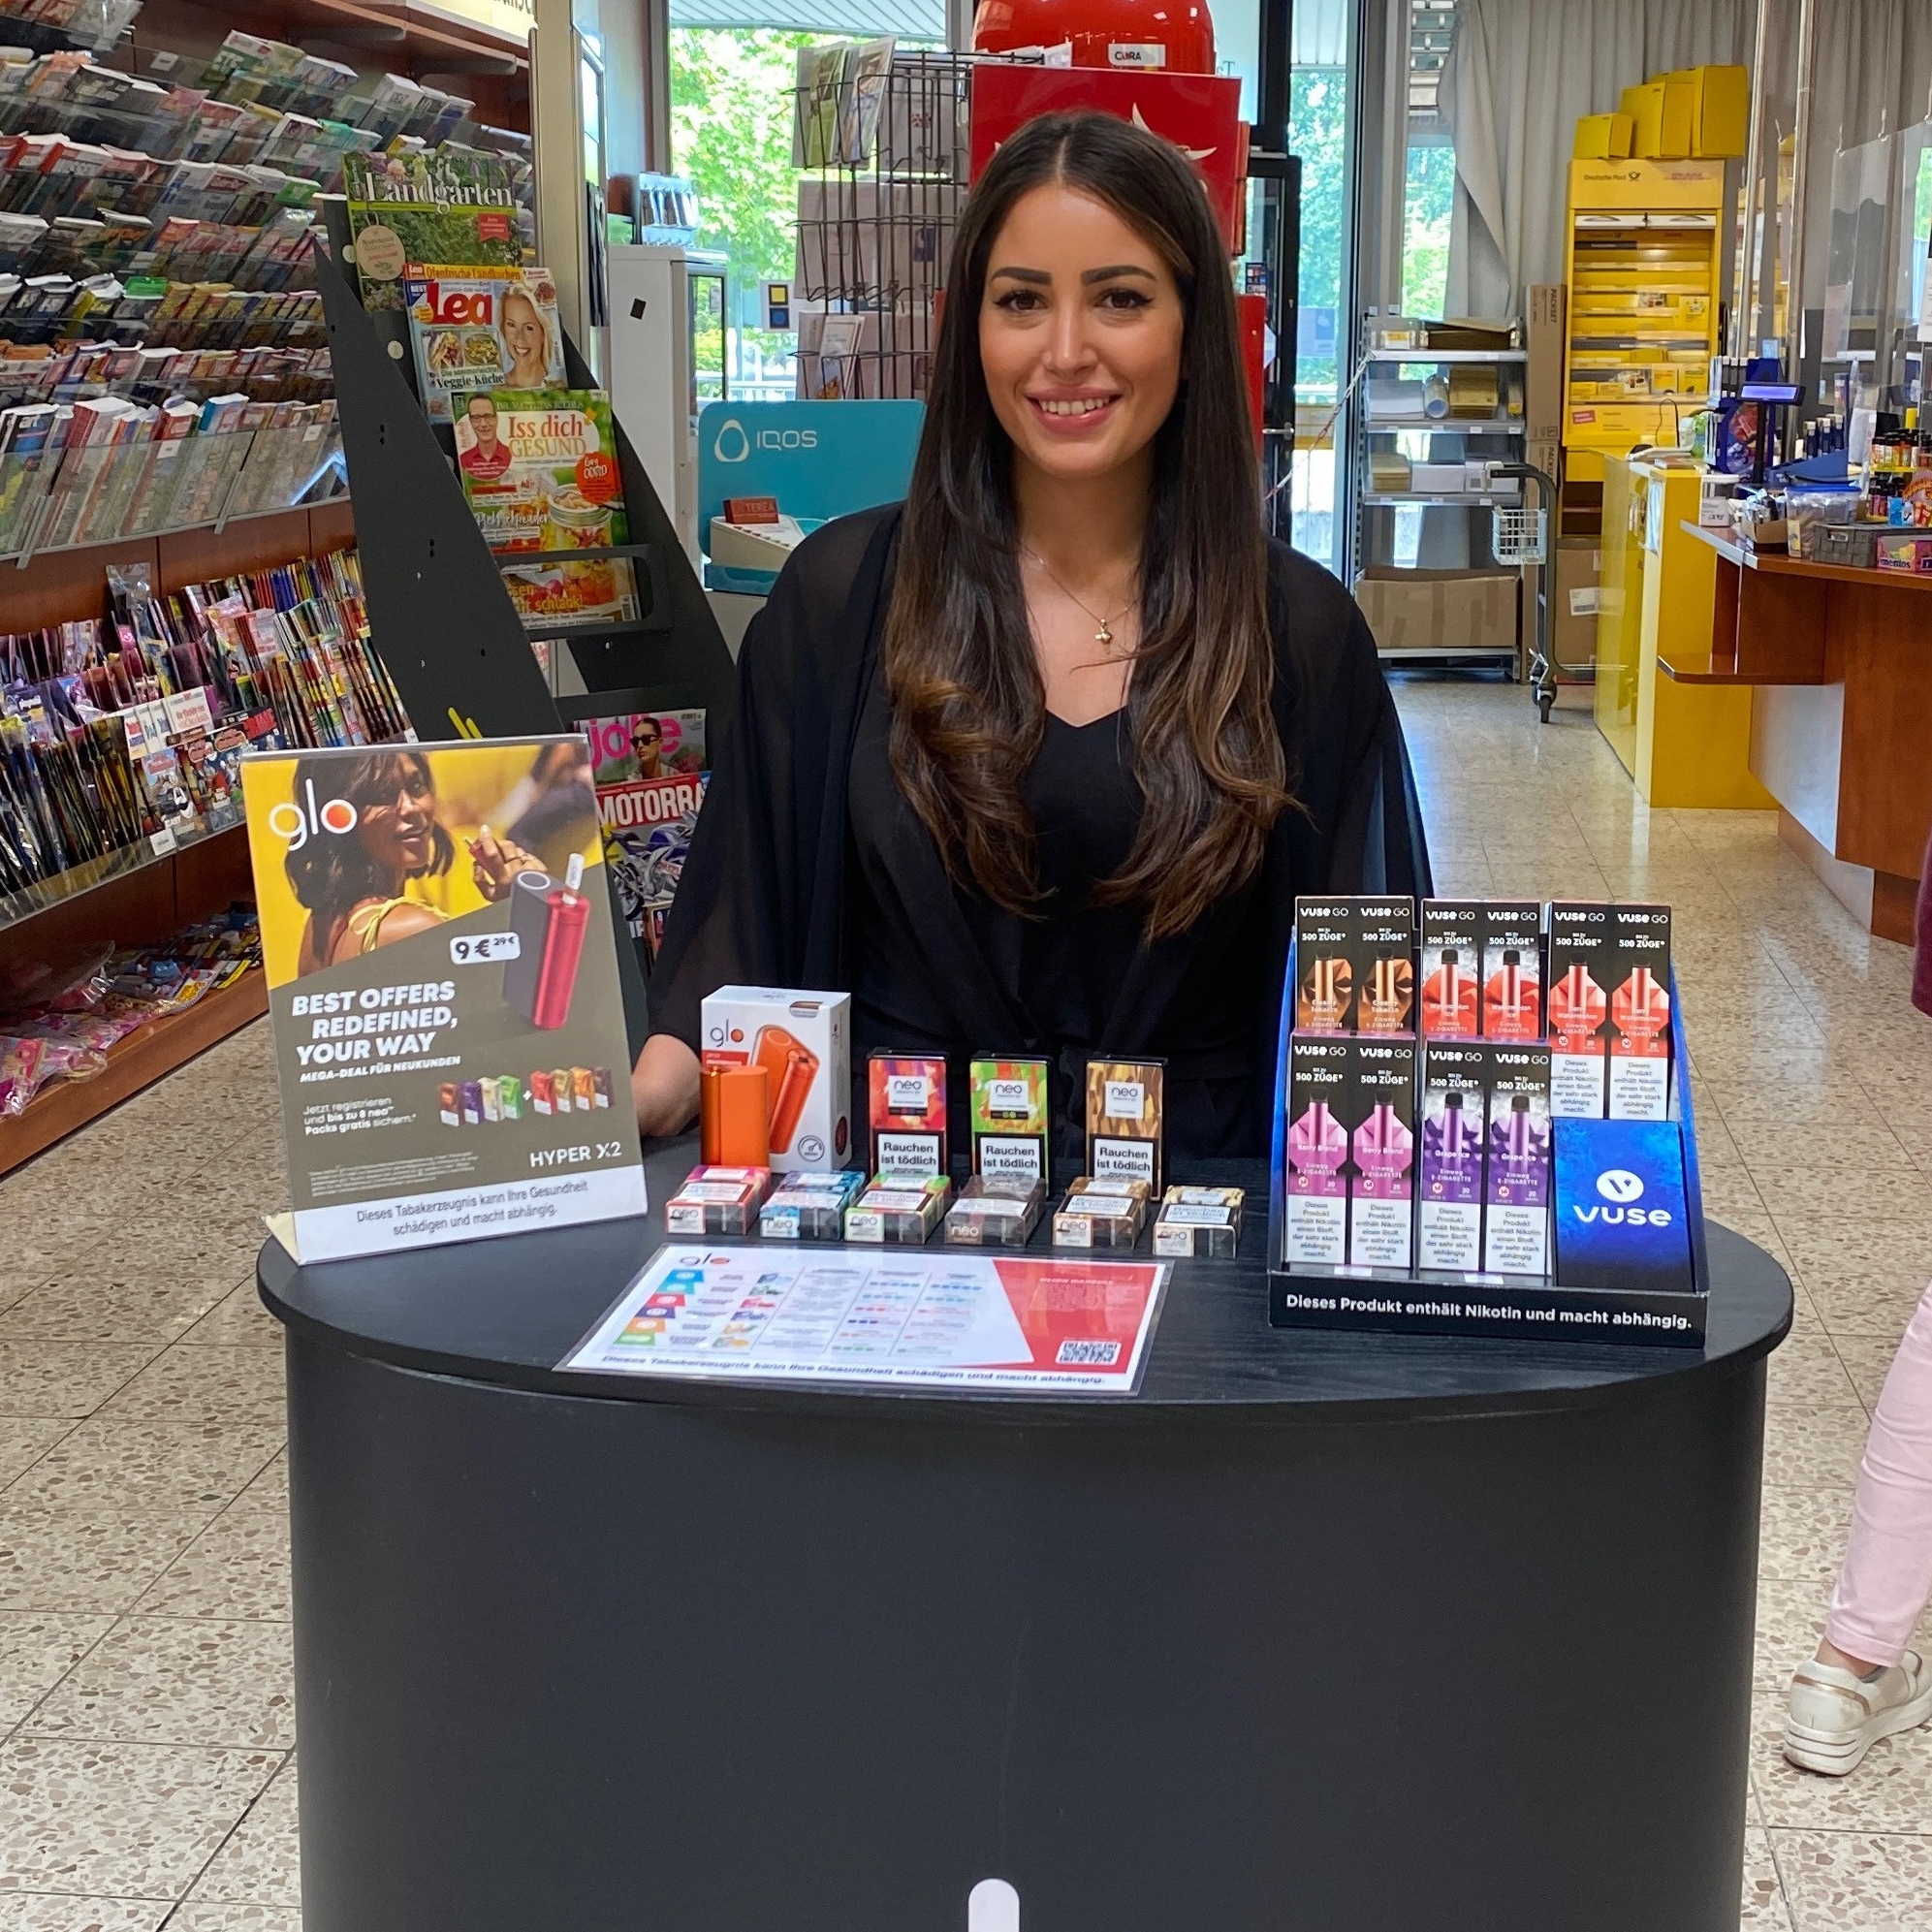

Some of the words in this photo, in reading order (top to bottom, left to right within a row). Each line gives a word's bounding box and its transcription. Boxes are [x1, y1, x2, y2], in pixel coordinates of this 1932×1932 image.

[427, 282, 492, 326] Lea
[508, 416, 536, 439] Iss
[541, 413, 584, 437] dich
[756, 429, 817, 451] IQOS
[509, 437, 587, 458] GESUND
[589, 713, 682, 771] joe
[595, 781, 705, 828] MOTORRA
[269, 777, 358, 851] glo
[1332, 907, 1349, 917] GO
[1393, 907, 1409, 917] GO
[1458, 910, 1475, 921] GO
[1520, 911, 1537, 921] GO
[1588, 912, 1605, 922] GO
[1651, 914, 1668, 924] GO
[1302, 933, 1317, 941] 500
[1362, 933, 1378, 941] 500
[1556, 937, 1571, 946] 500
[1619, 939, 1634, 948] 500
[455, 941, 469, 960] 9
[292, 990, 357, 1016] BEST
[359, 980, 456, 1010] OFFERS
[312, 1005, 459, 1039] REDEFINED,
[710, 1019, 744, 1047] glo
[296, 1038, 371, 1065] YOUR
[375, 1030, 436, 1057] WAY
[1329, 1046, 1347, 1058] GO
[1394, 1048, 1412, 1059] GO
[1465, 1051, 1483, 1062] GO
[1531, 1055, 1549, 1065] GO
[300, 1065, 369, 1083] MEGA-DEAL
[370, 1061, 392, 1075] FÜR
[393, 1055, 460, 1072] NEUKUNDEN
[1296, 1072, 1312, 1082] 500
[1361, 1074, 1378, 1084] 500
[1430, 1077, 1447, 1087] 500
[894, 1080, 922, 1091] neo
[995, 1083, 1023, 1094] neo
[1497, 1080, 1514, 1090] 500
[1111, 1087, 1139, 1097] neo
[304, 1123, 337, 1136] Packs
[883, 1142, 934, 1154] Rauchen
[986, 1145, 1035, 1156] Rauchen
[1099, 1147, 1149, 1159] Rauchen
[529, 1146, 591, 1168] HYPER
[596, 1141, 623, 1159] X2
[881, 1155, 896, 1165] ist
[897, 1154, 936, 1166] tödlich
[983, 1157, 998, 1168] ist
[999, 1157, 1038, 1170] tödlich
[1096, 1160, 1111, 1170] ist
[1113, 1159, 1152, 1172] tödlich
[356, 1208, 393, 1223] Dieses
[396, 1194, 478, 1219] Tabakerzeugnis
[479, 1190, 506, 1206] kann
[507, 1187, 527, 1202] Ihre
[529, 1179, 588, 1200] Gesundheit
[393, 1217, 448, 1239] schädigen
[450, 1213, 471, 1228] und
[472, 1209, 505, 1225] macht
[506, 1201, 557, 1222] abhängig.
[1286, 1292, 1337, 1311] Dieses
[1340, 1296, 1403, 1314] Produkt
[1406, 1299, 1462, 1317] enthält
[1465, 1302, 1522, 1321] Nikotin
[1526, 1308, 1556, 1321] und
[1559, 1308, 1609, 1325] macht
[1612, 1309, 1693, 1331] abhängig.
